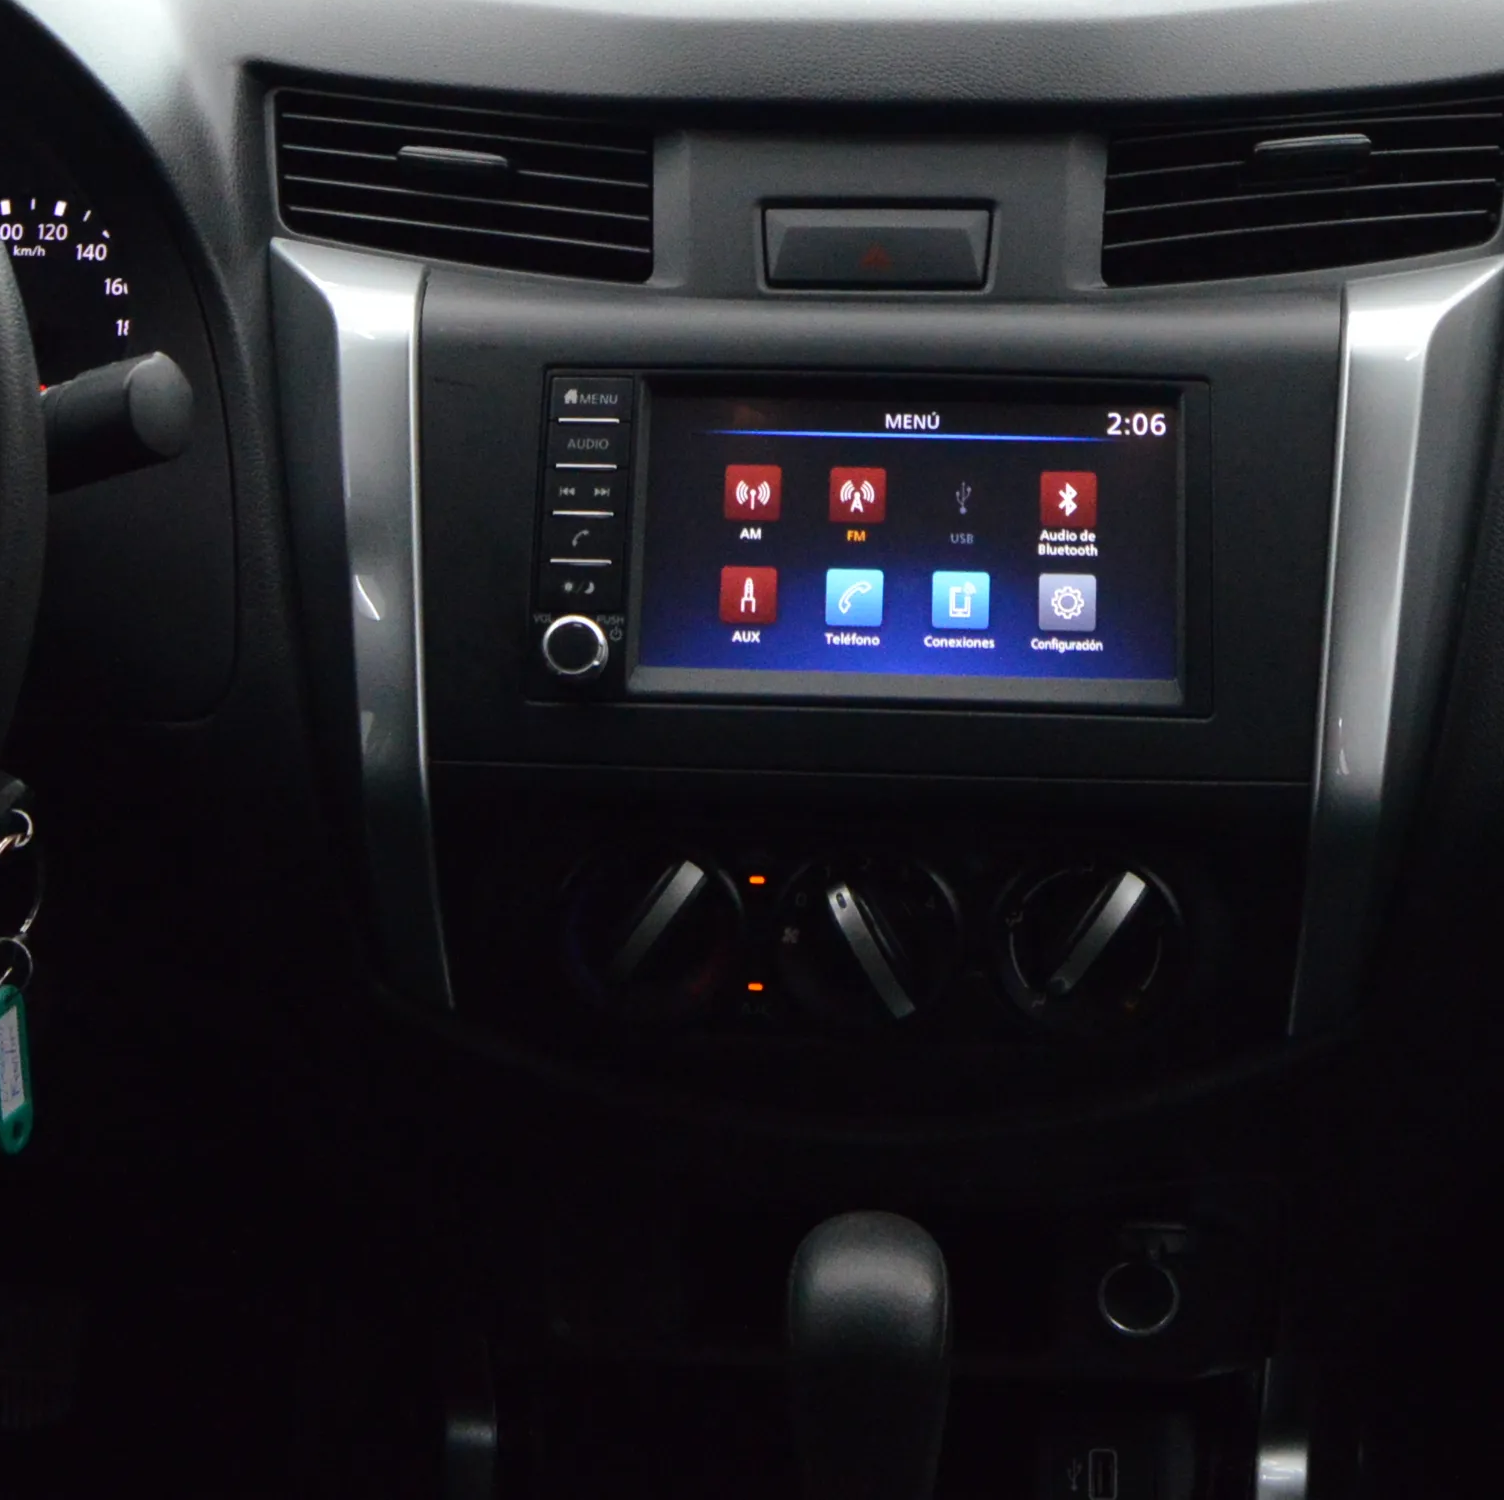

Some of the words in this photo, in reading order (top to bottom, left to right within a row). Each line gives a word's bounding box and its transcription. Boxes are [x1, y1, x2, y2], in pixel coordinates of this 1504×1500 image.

[37, 223, 68, 241] 120
[12, 245, 46, 257] km/h
[76, 243, 108, 261] 140
[579, 393, 619, 406] MENU
[885, 411, 940, 430] MENÚ
[1106, 411, 1167, 436] 2:06
[567, 437, 610, 450] AUDIO
[739, 527, 762, 541] AM
[847, 529, 866, 542] FM
[950, 532, 975, 545] USB
[1039, 529, 1077, 542] Audio
[1079, 529, 1096, 542] de
[1038, 544, 1098, 557] Bluetooth
[731, 630, 761, 644] AUX
[824, 631, 881, 647] Teléfono
[923, 635, 995, 650] Conexiones
[1030, 637, 1104, 654] Configuración
